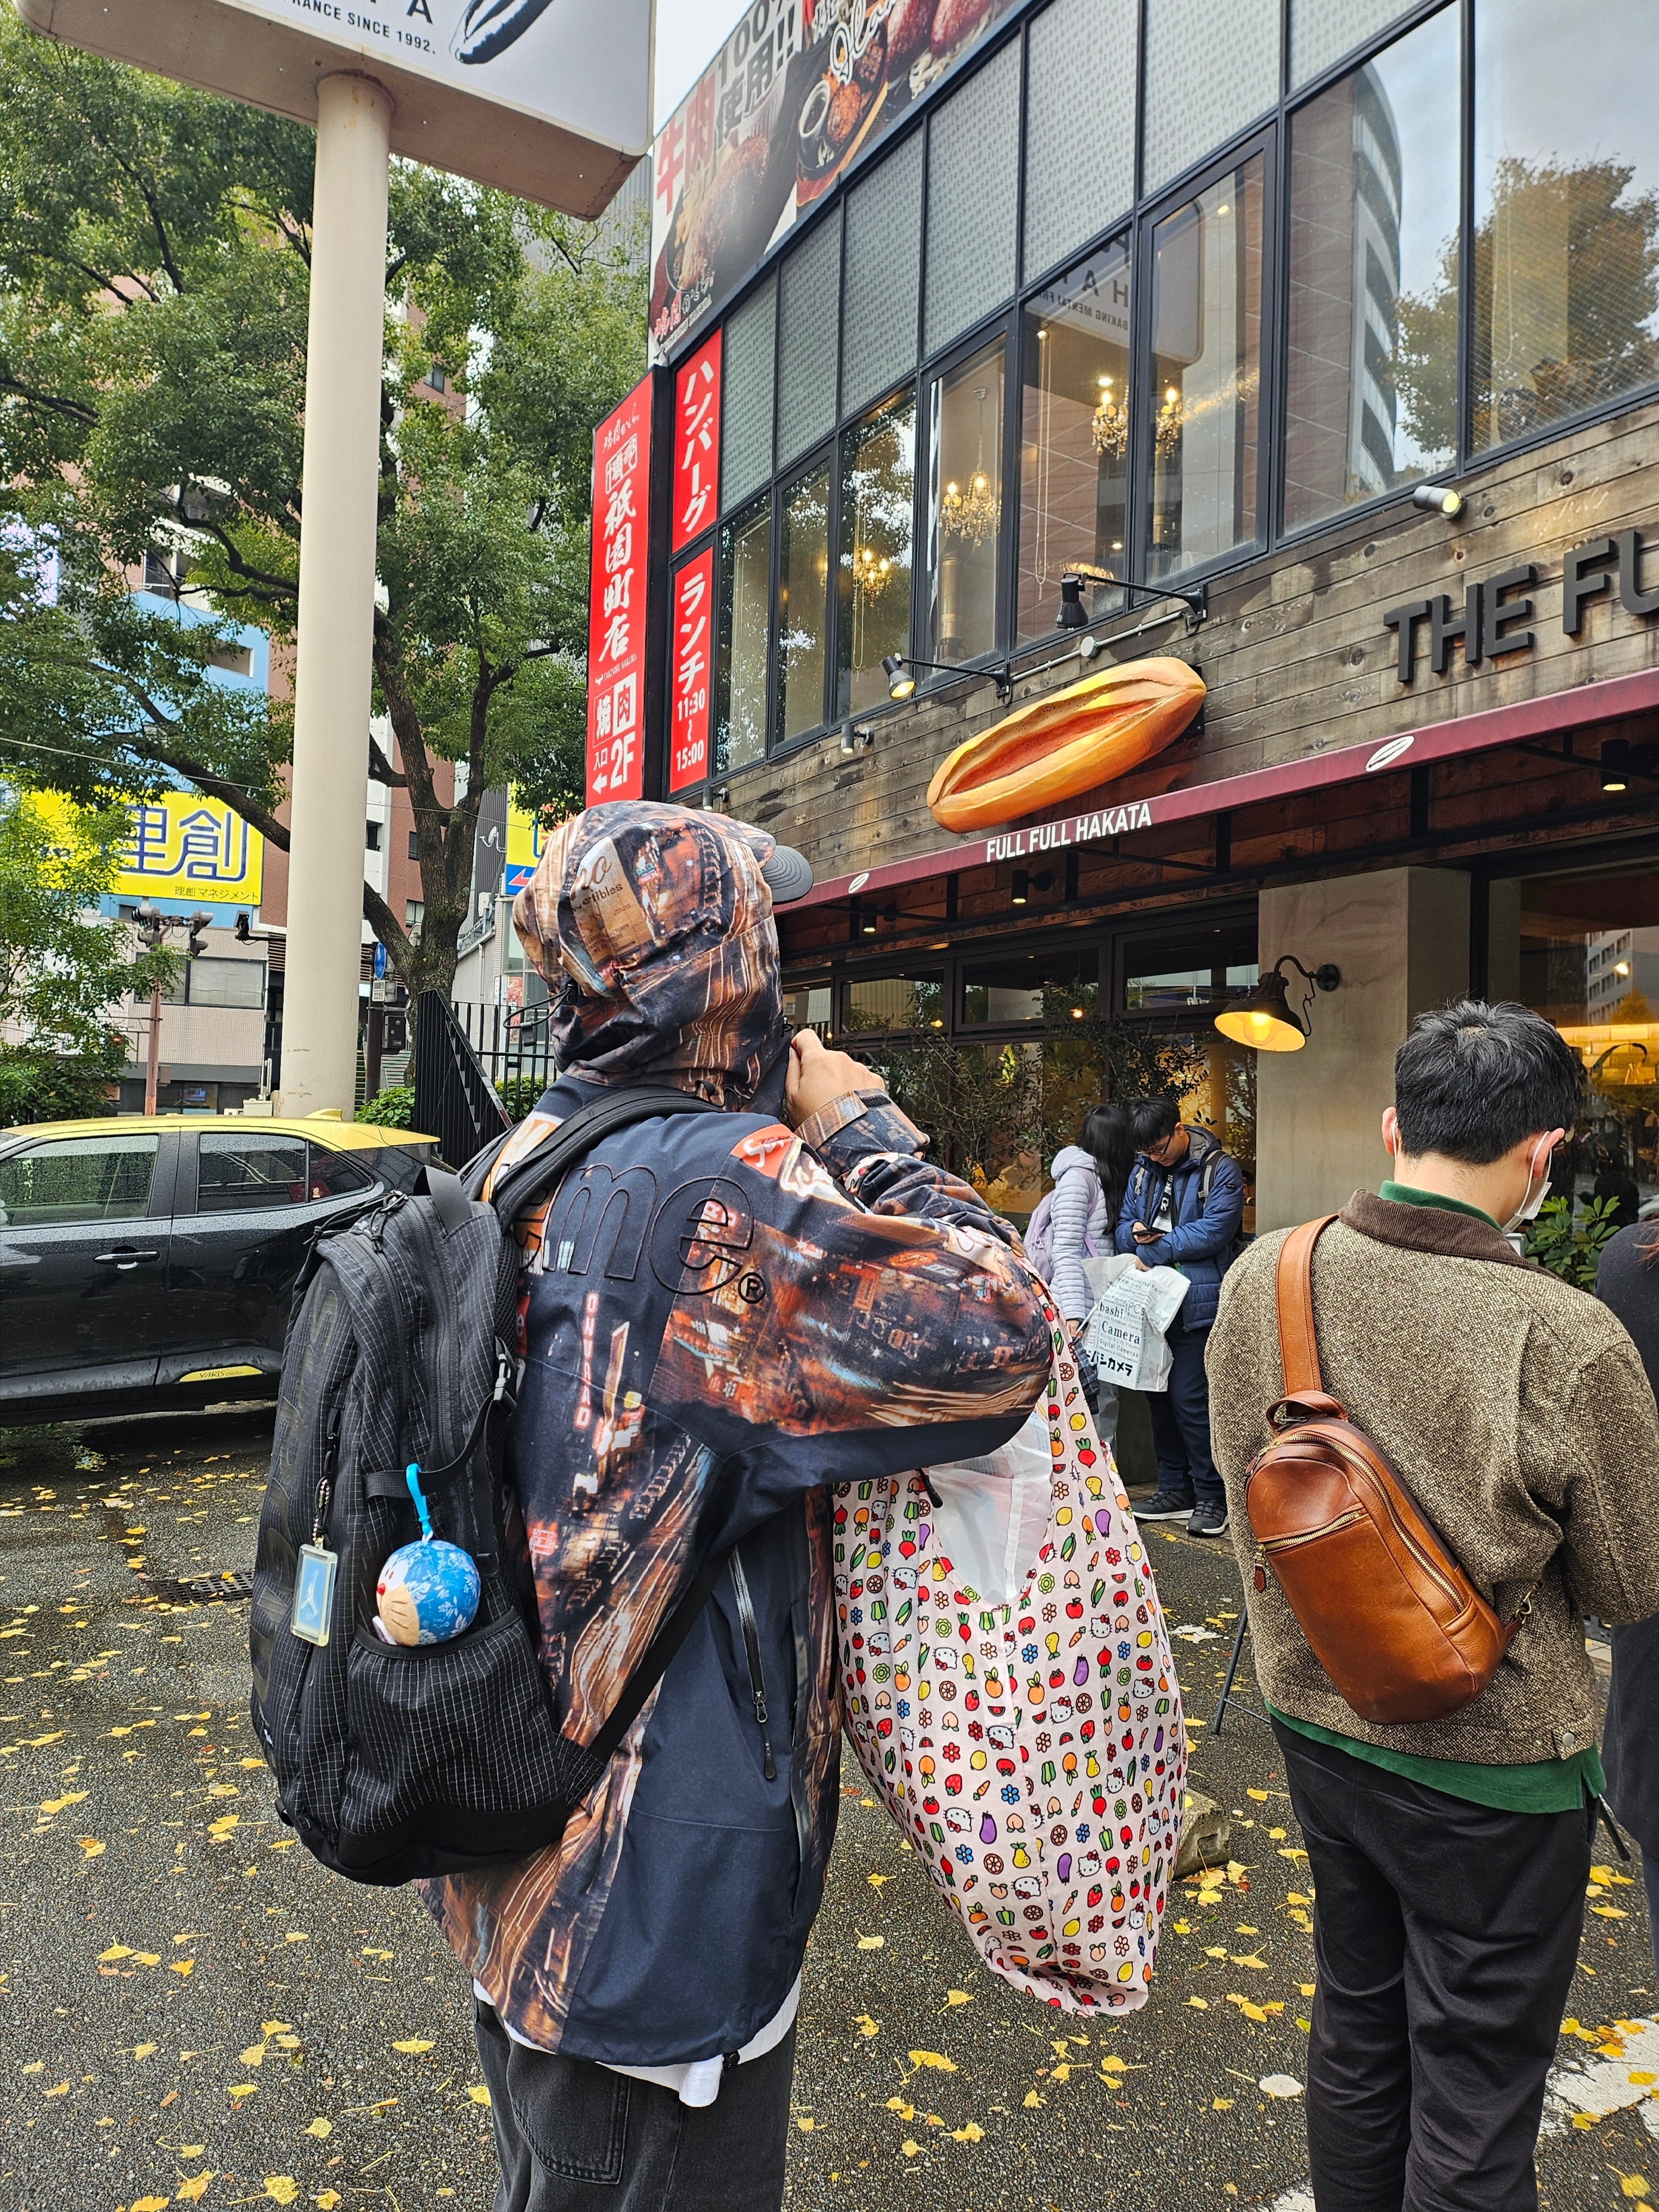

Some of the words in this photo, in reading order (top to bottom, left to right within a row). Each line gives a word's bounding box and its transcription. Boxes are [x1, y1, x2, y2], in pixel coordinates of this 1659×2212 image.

[347, 12, 390, 38] SINCE
[397, 30, 436, 54] 1992.
[681, 360, 714, 533] ハンバーグ
[678, 571, 707, 694] ランチ
[1383, 565, 1537, 684] THE
[595, 672, 636, 740] 焼肉
[677, 688, 705, 722] 11:30
[594, 748, 608, 771] 入口
[610, 731, 636, 790] 2F
[676, 740, 704, 772] 15:00
[986, 833, 1026, 863] FULL
[1029, 826, 1072, 853] FULL
[1074, 802, 1152, 841] HAKATA
[197, 888, 258, 902] マネジメント
[1128, 1301, 1145, 1317] PCs
[1099, 1339, 1115, 1349] Digital
[1117, 1345, 1139, 1358] Cameras
[1101, 1320, 1140, 1345] Camera
[199, 1370, 225, 1378] YARIS
